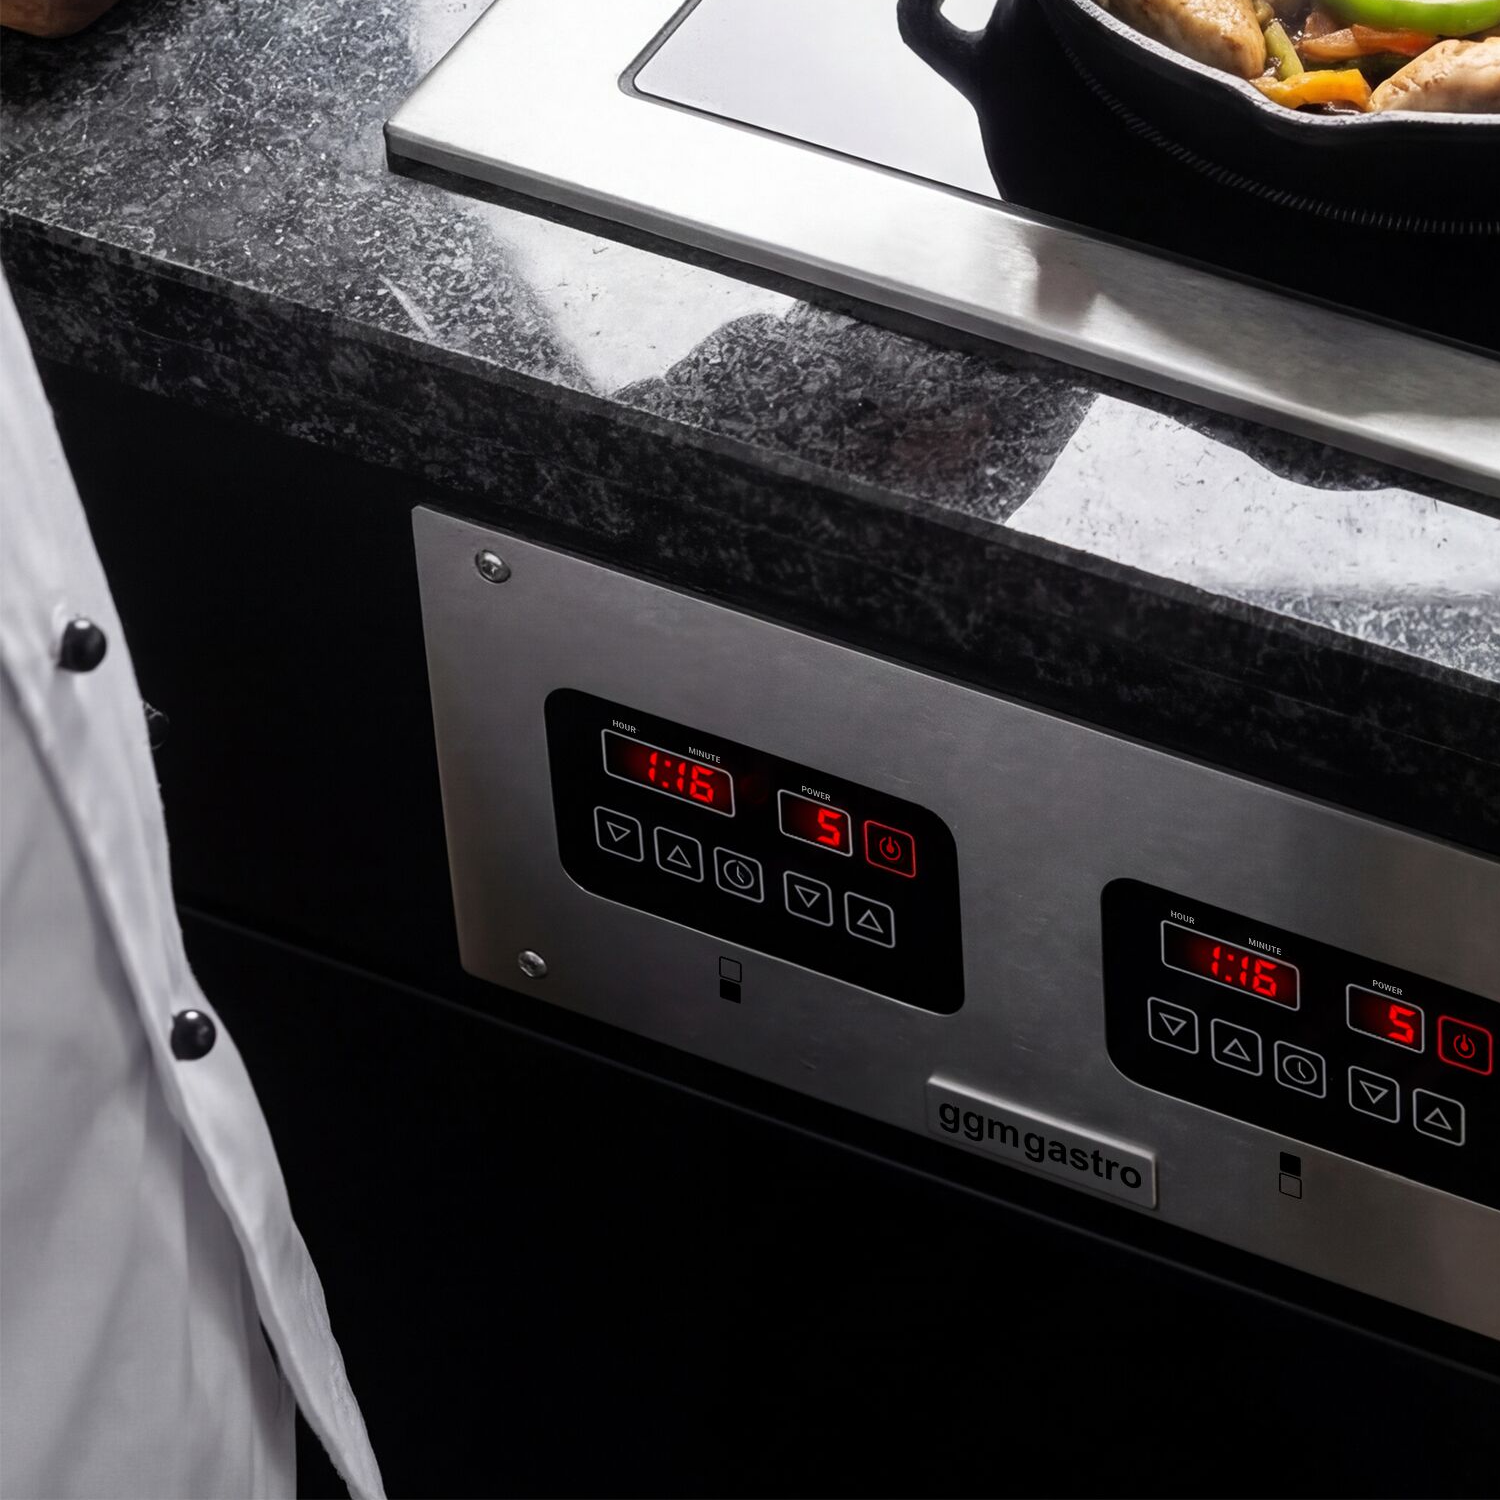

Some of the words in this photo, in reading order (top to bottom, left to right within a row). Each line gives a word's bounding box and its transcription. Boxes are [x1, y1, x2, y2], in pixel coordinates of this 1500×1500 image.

[612, 719, 637, 734] HOUR
[688, 746, 721, 764] MINUTE
[648, 751, 715, 803] 1:16
[801, 785, 831, 802] POWER
[1170, 910, 1195, 925] HOUR
[1248, 937, 1282, 956] MINUTE
[1211, 944, 1278, 998] 1:16
[1372, 979, 1403, 996] POWER
